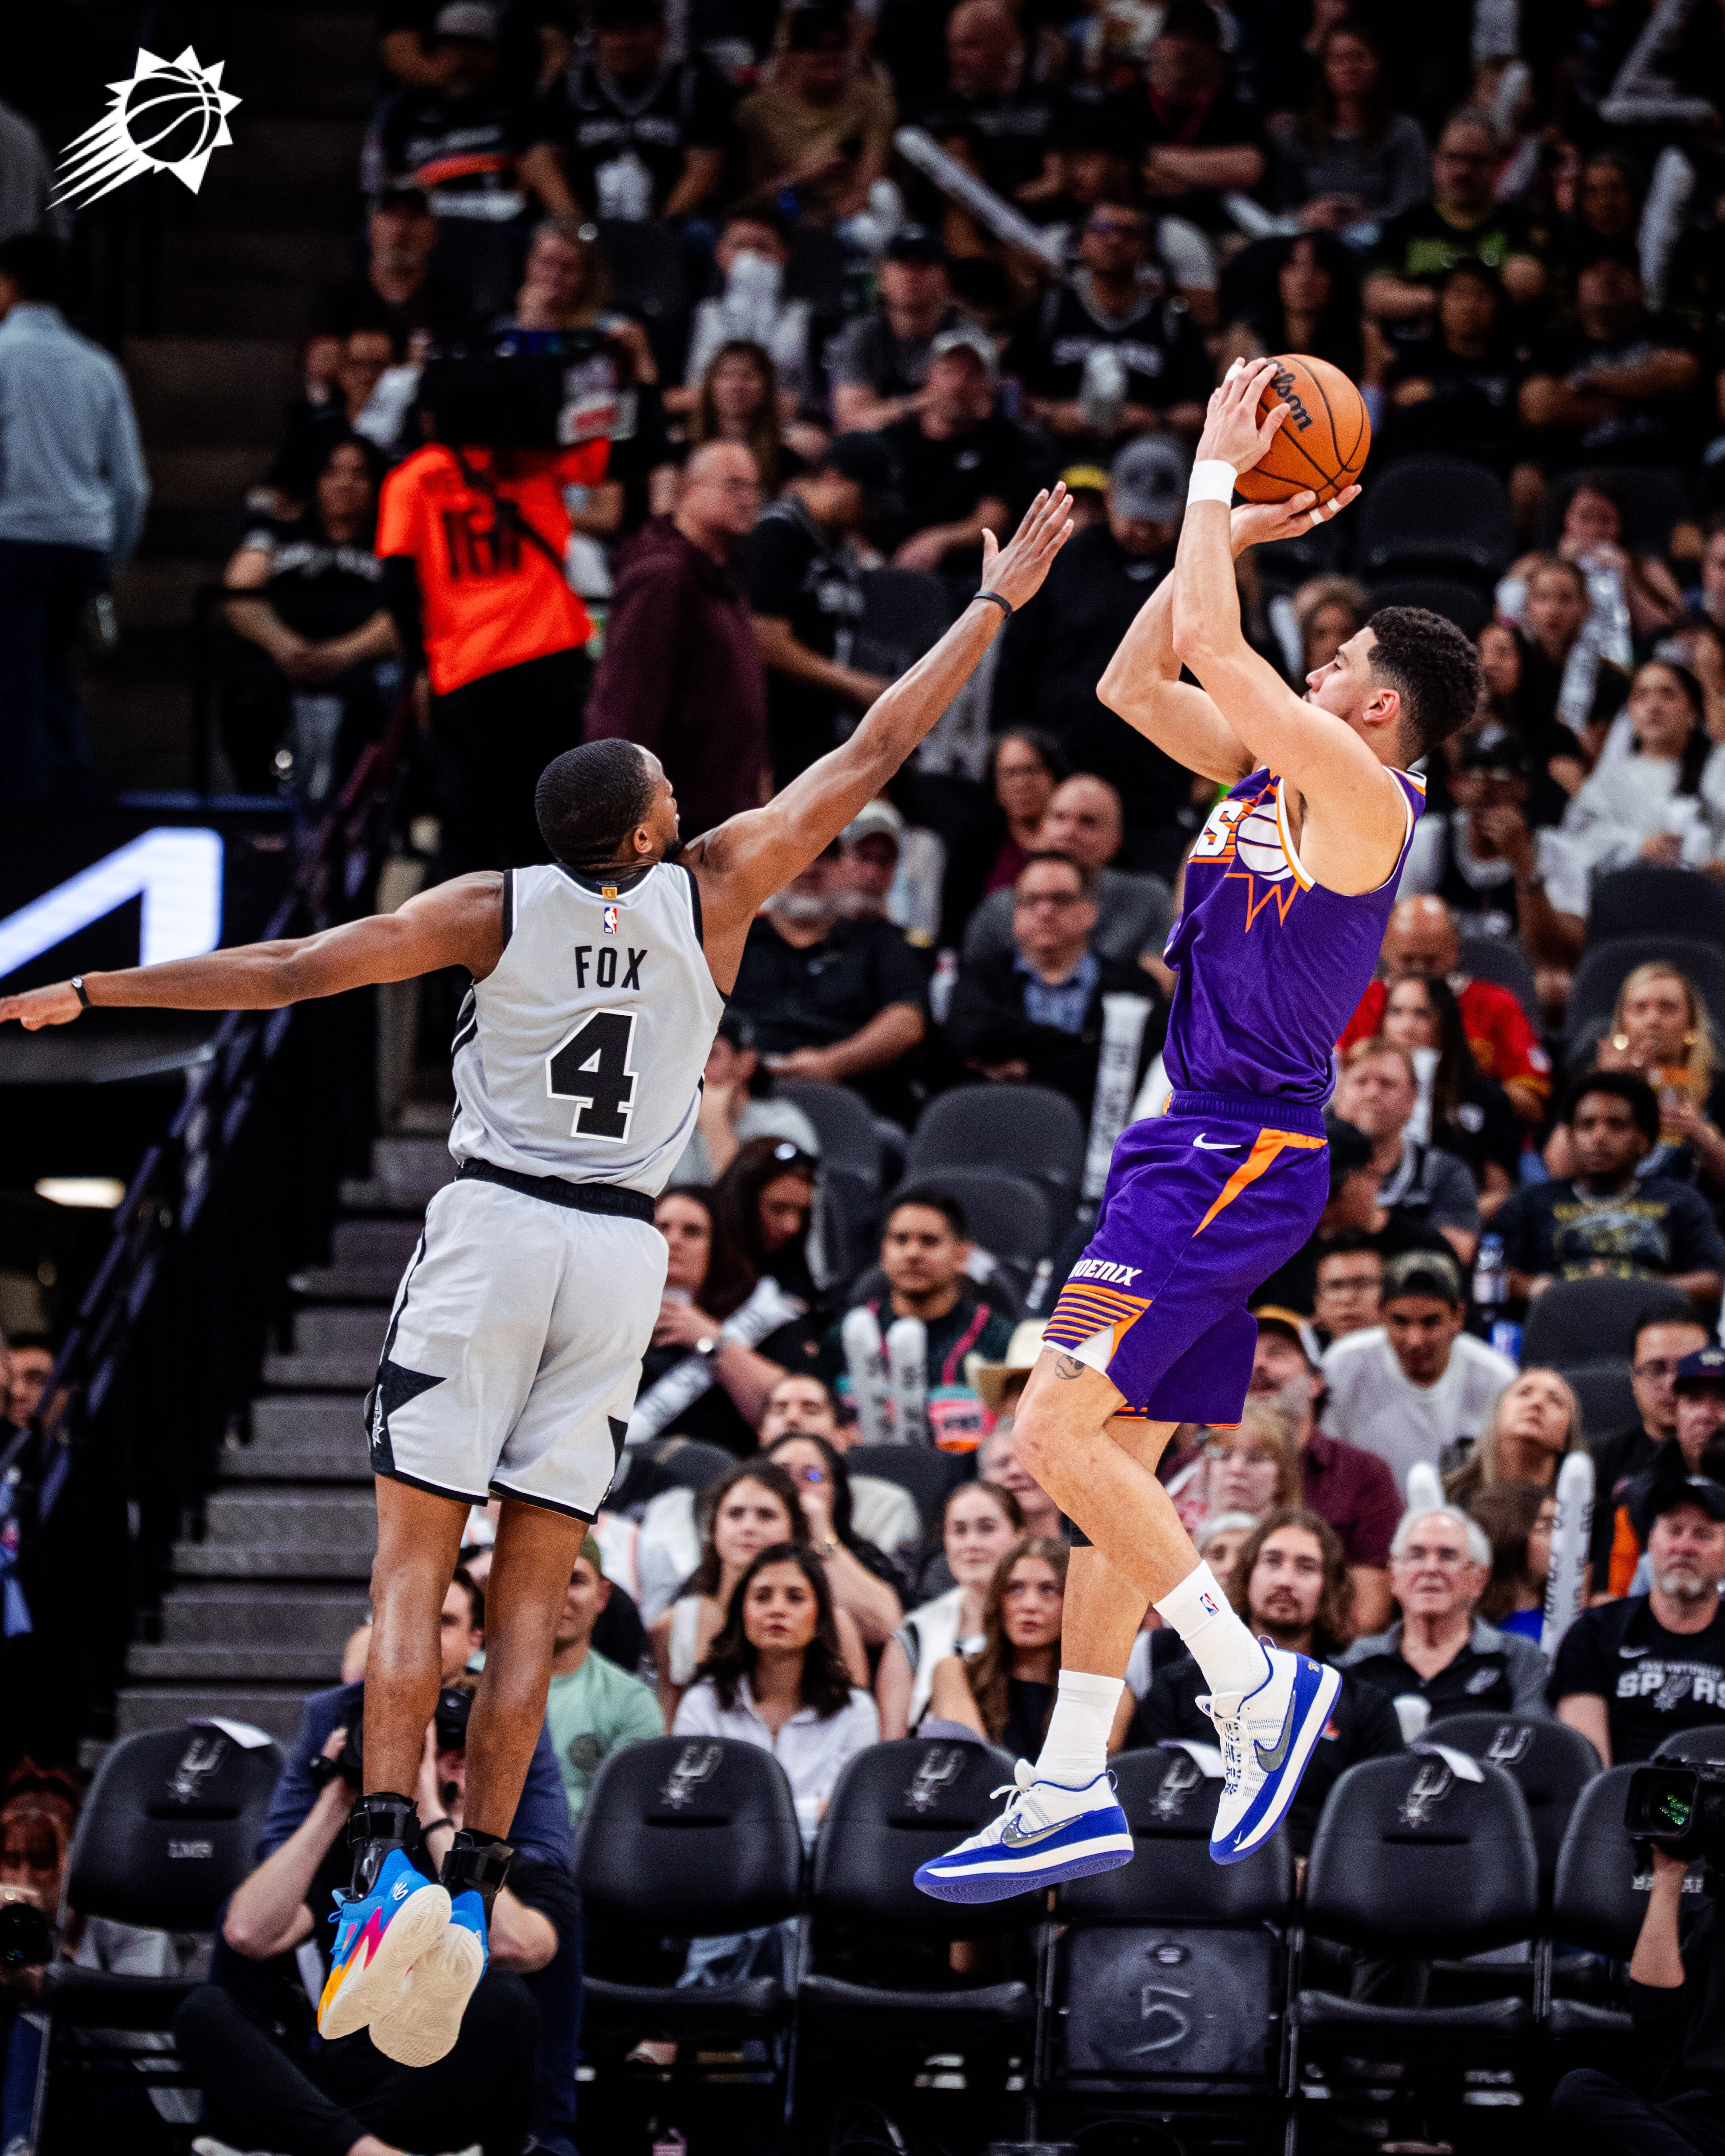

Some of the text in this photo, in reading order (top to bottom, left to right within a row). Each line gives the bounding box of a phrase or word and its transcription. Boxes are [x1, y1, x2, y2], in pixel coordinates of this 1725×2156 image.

[575, 945, 648, 991] FOX
[545, 1008, 639, 1144] 4
[1127, 1985, 1193, 2055] 5
